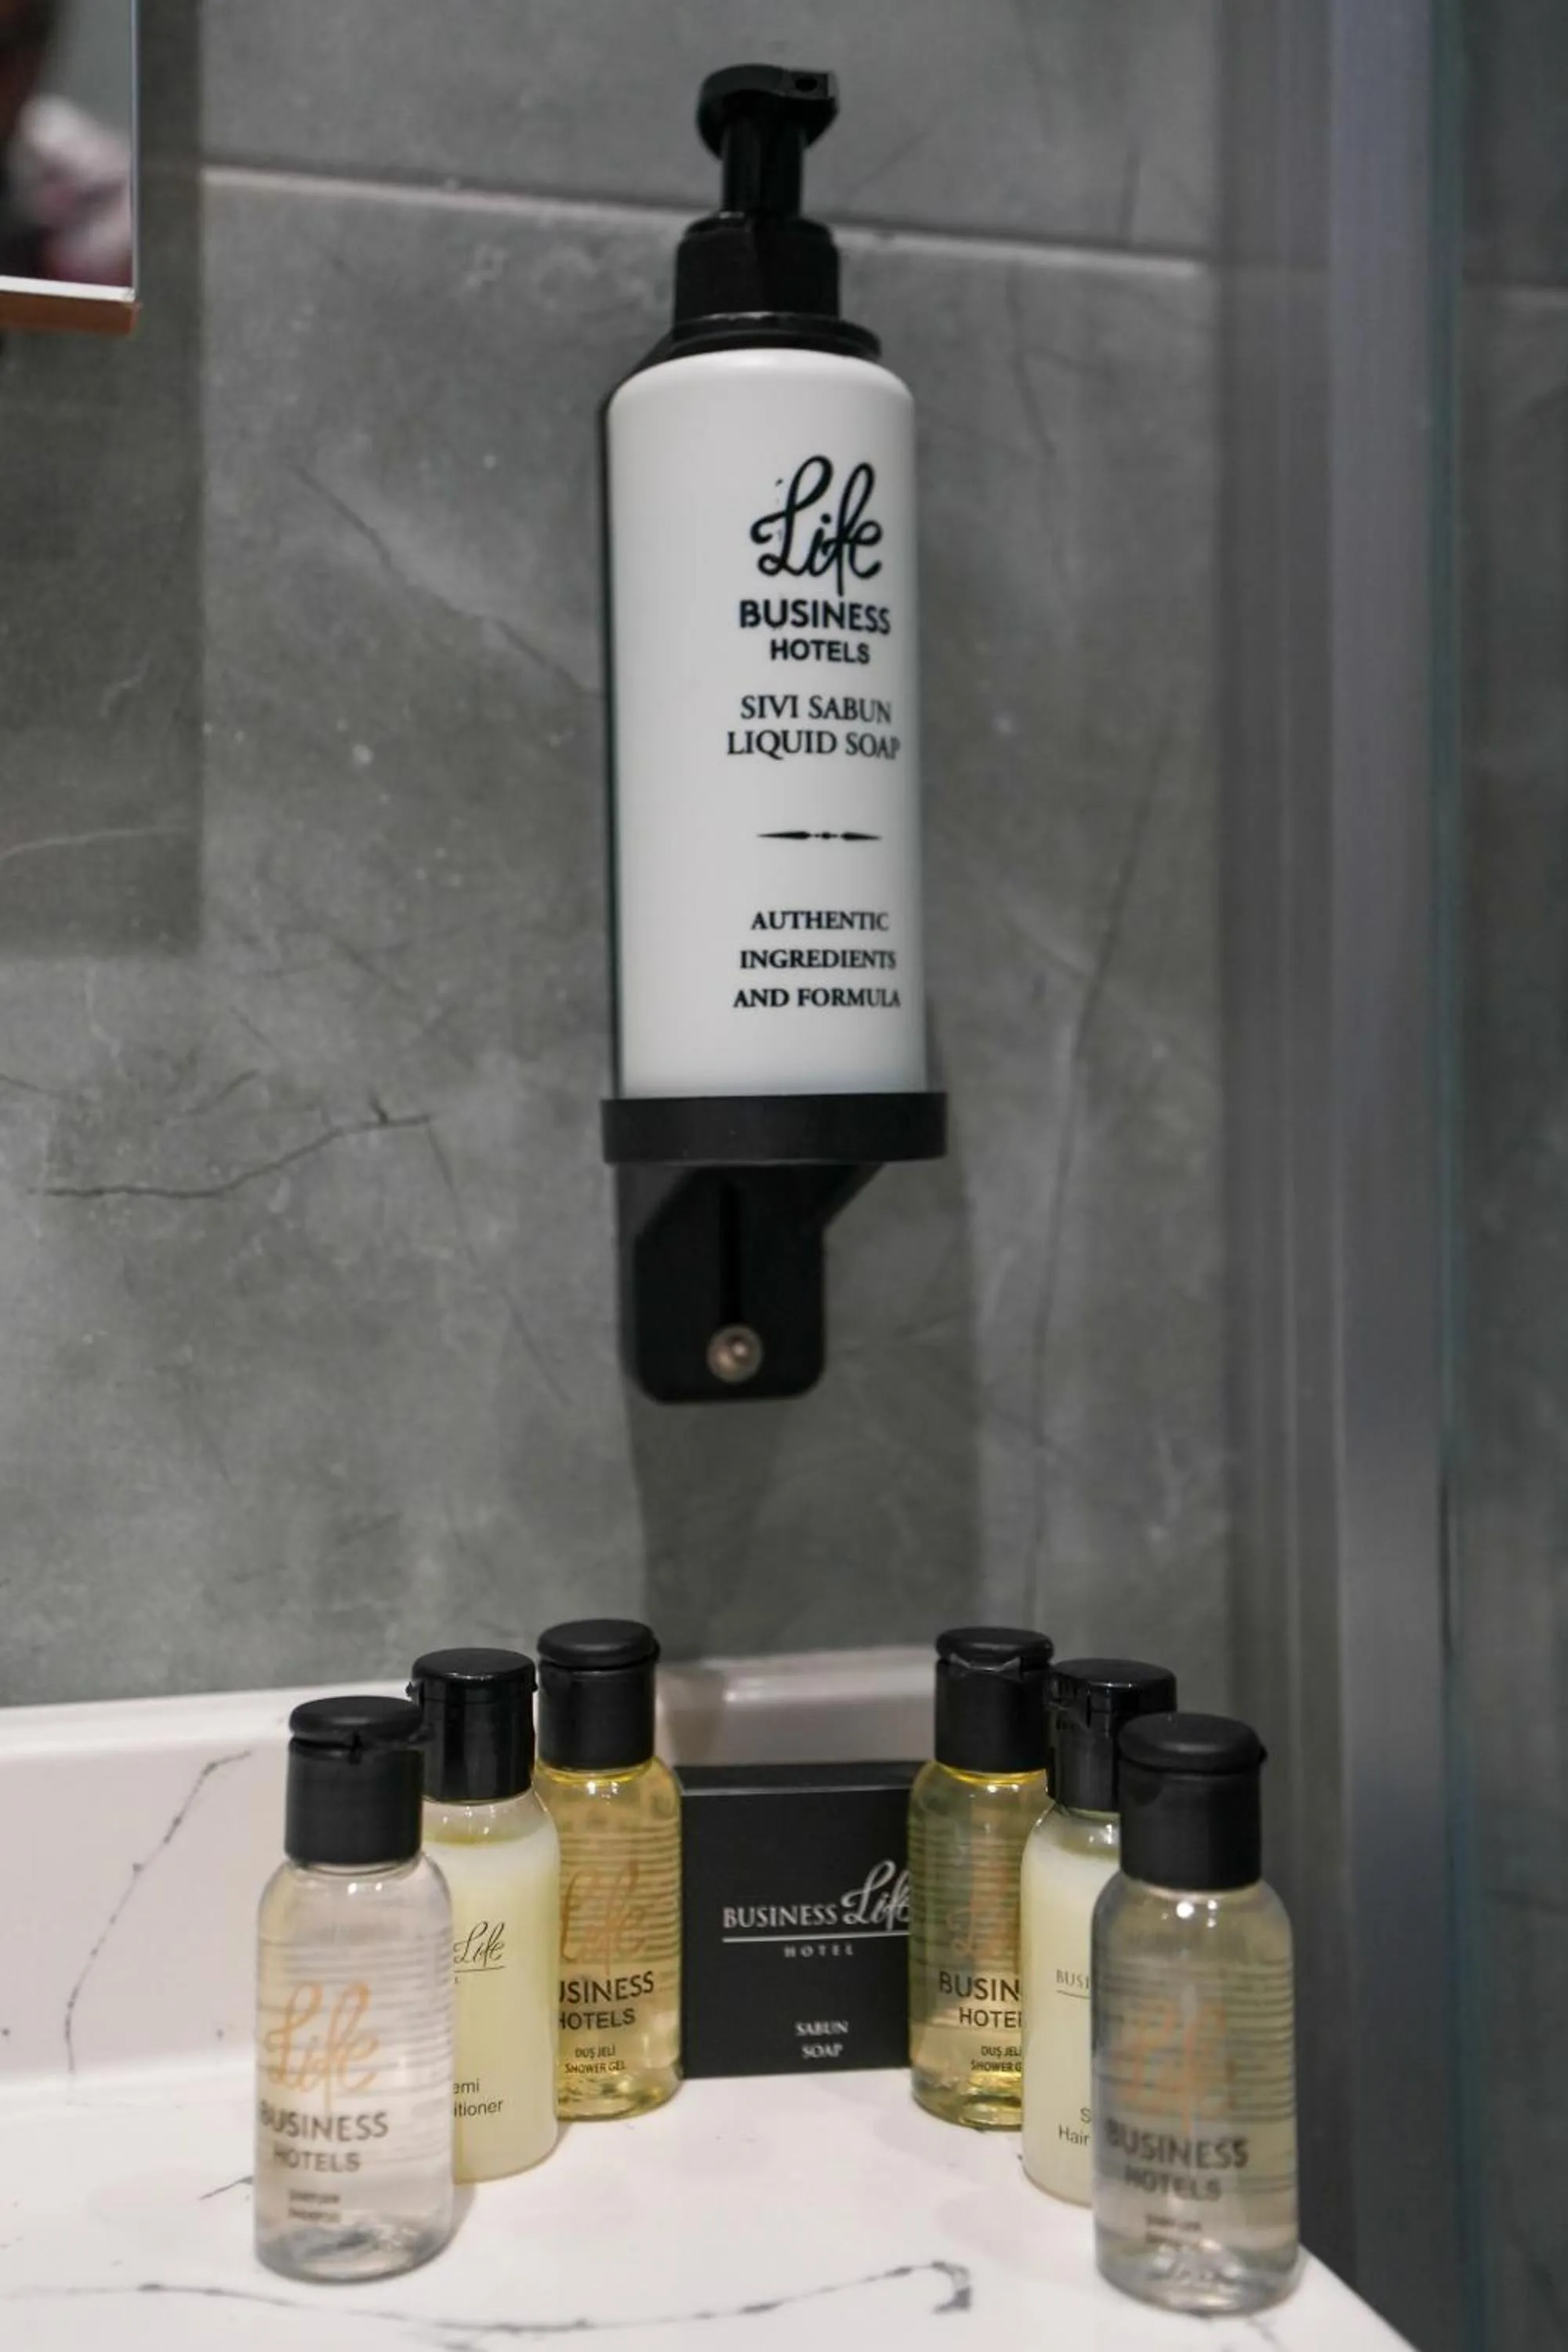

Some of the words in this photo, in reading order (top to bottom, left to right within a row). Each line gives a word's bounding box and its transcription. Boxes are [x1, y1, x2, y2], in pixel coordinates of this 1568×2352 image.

[750, 455, 883, 597] Life
[739, 600, 891, 635] BUSINESS
[771, 639, 869, 664] HOTELS
[741, 695, 798, 719] SIVI
[808, 695, 891, 724] SABUN
[728, 731, 837, 760] LIQUID
[845, 732, 900, 760] SOAP
[750, 911, 889, 931] AUTHENTIC
[739, 949, 897, 970] INGREDIENTS
[733, 989, 789, 1007] AND
[797, 989, 901, 1007] FORMULA
[722, 1904, 837, 1929] BUSINESS
[452, 1920, 505, 1968] Life
[784, 1944, 854, 1958] HOTEL
[795, 2020, 848, 2036] SABUN
[263, 1981, 379, 2115] Life
[802, 2042, 843, 2059] SOAP
[564, 2062, 606, 2074] SHOWER
[608, 2060, 626, 2071] GEL
[971, 2060, 1012, 2072] SHOWER
[260, 2099, 389, 2142] BUSINESS
[1058, 2124, 1091, 2147] Hair
[1105, 2119, 1249, 2169] BUSINESS
[274, 2140, 361, 2172] HOTELS
[1124, 2165, 1221, 2201] HOTELS
